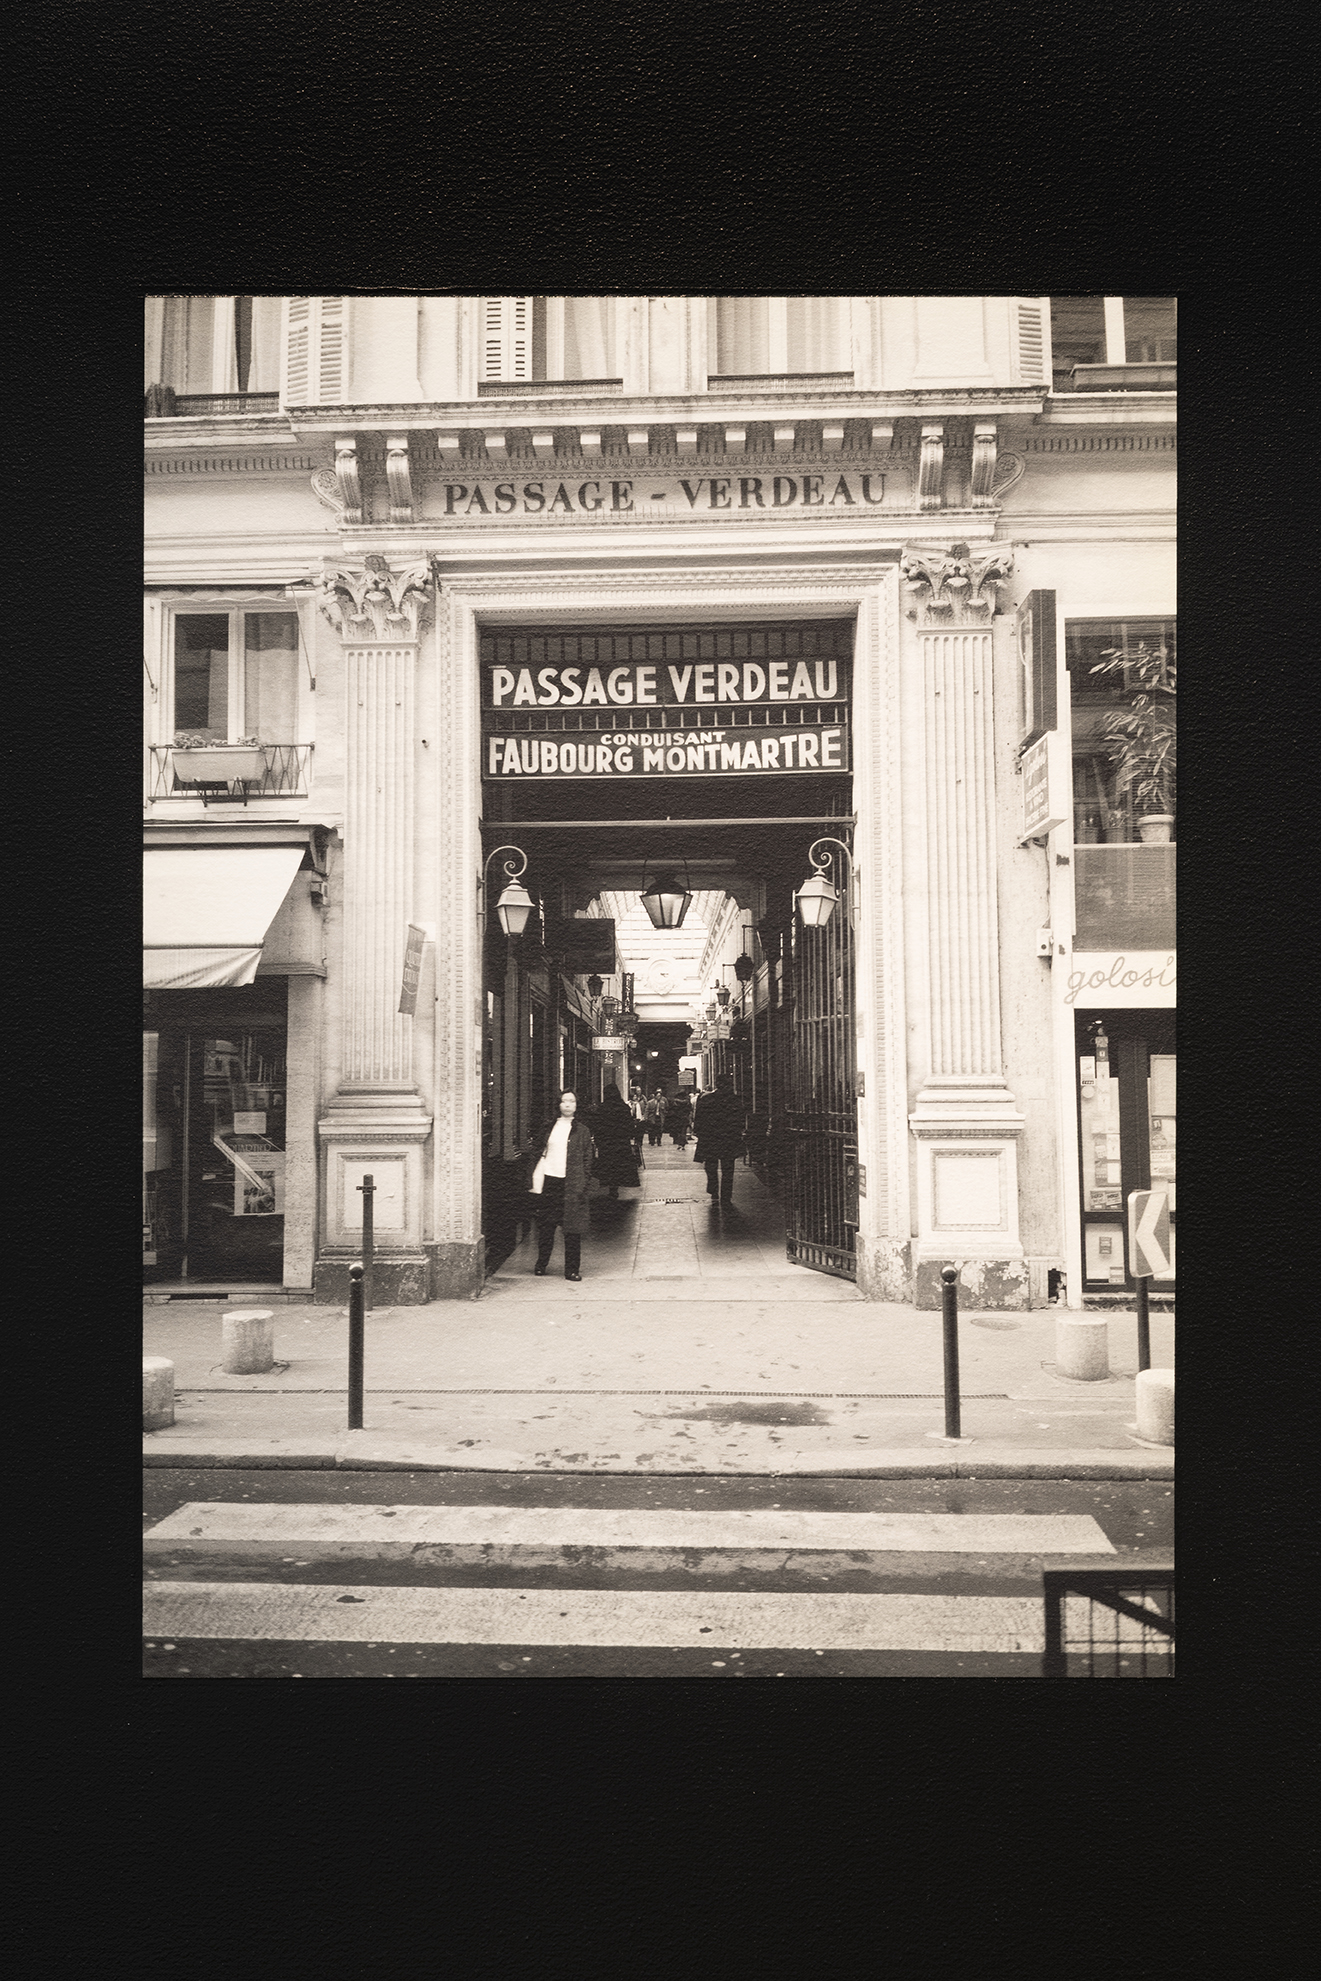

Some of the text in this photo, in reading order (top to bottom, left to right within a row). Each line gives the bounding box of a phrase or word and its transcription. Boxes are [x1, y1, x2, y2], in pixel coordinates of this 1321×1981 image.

[443, 481, 635, 516] PASSAGE
[679, 473, 888, 511] VERDEAU
[492, 660, 837, 706] PASSAGE VERDEAU
[489, 729, 842, 774] FAUBOURG MONTMARTRE
[600, 731, 726, 746] CONDUISANT
